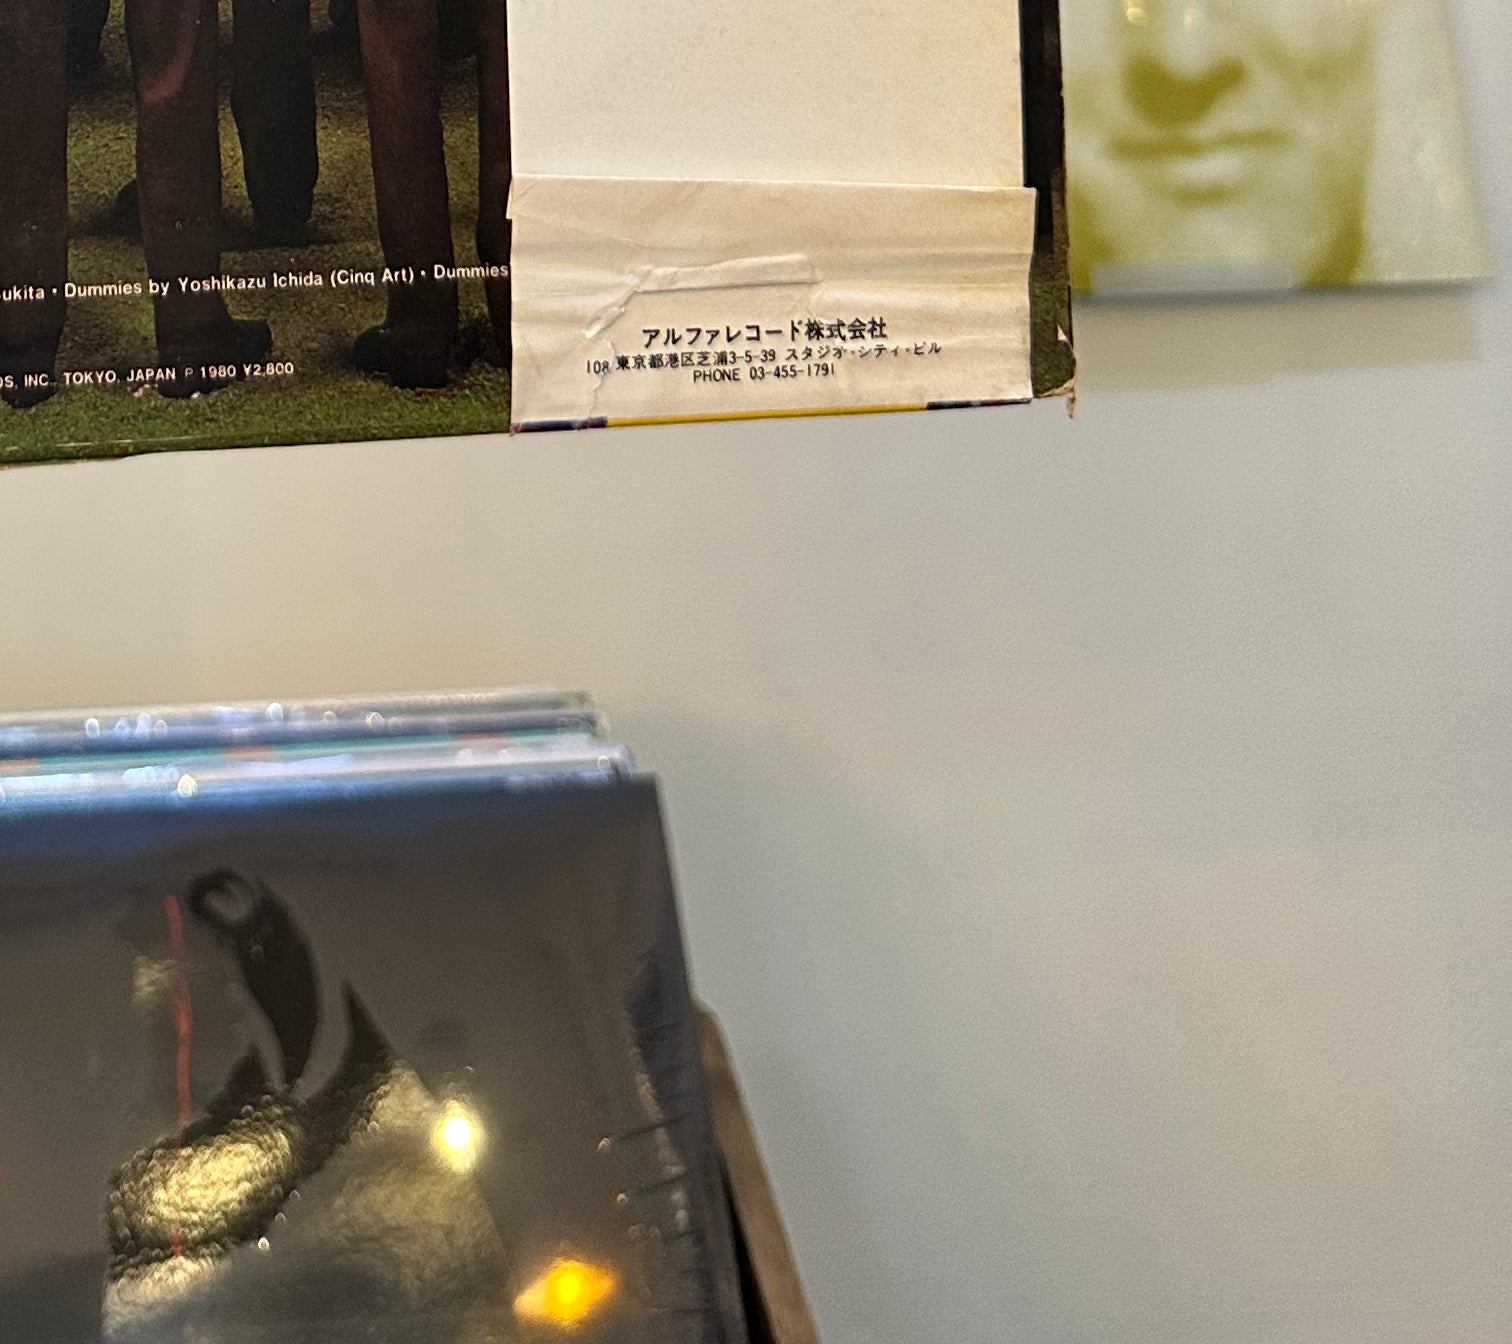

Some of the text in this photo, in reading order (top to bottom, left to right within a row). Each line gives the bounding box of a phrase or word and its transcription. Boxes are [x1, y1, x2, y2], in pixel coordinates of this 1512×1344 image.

[64, 279, 143, 299] Dummies
[149, 277, 170, 297] by
[177, 273, 267, 293] Yoshikazu
[272, 270, 323, 289] Ichida
[330, 268, 375, 288] (Cinq
[381, 265, 415, 285] Art)
[433, 262, 509, 282] Dummies
[641, 316, 888, 349] アルファレコード株式会社
[126, 367, 176, 383] JAPAN
[199, 365, 237, 380] 1980
[243, 362, 295, 379] ¥2,800
[692, 361, 835, 384] PHONE 03-455-1791
